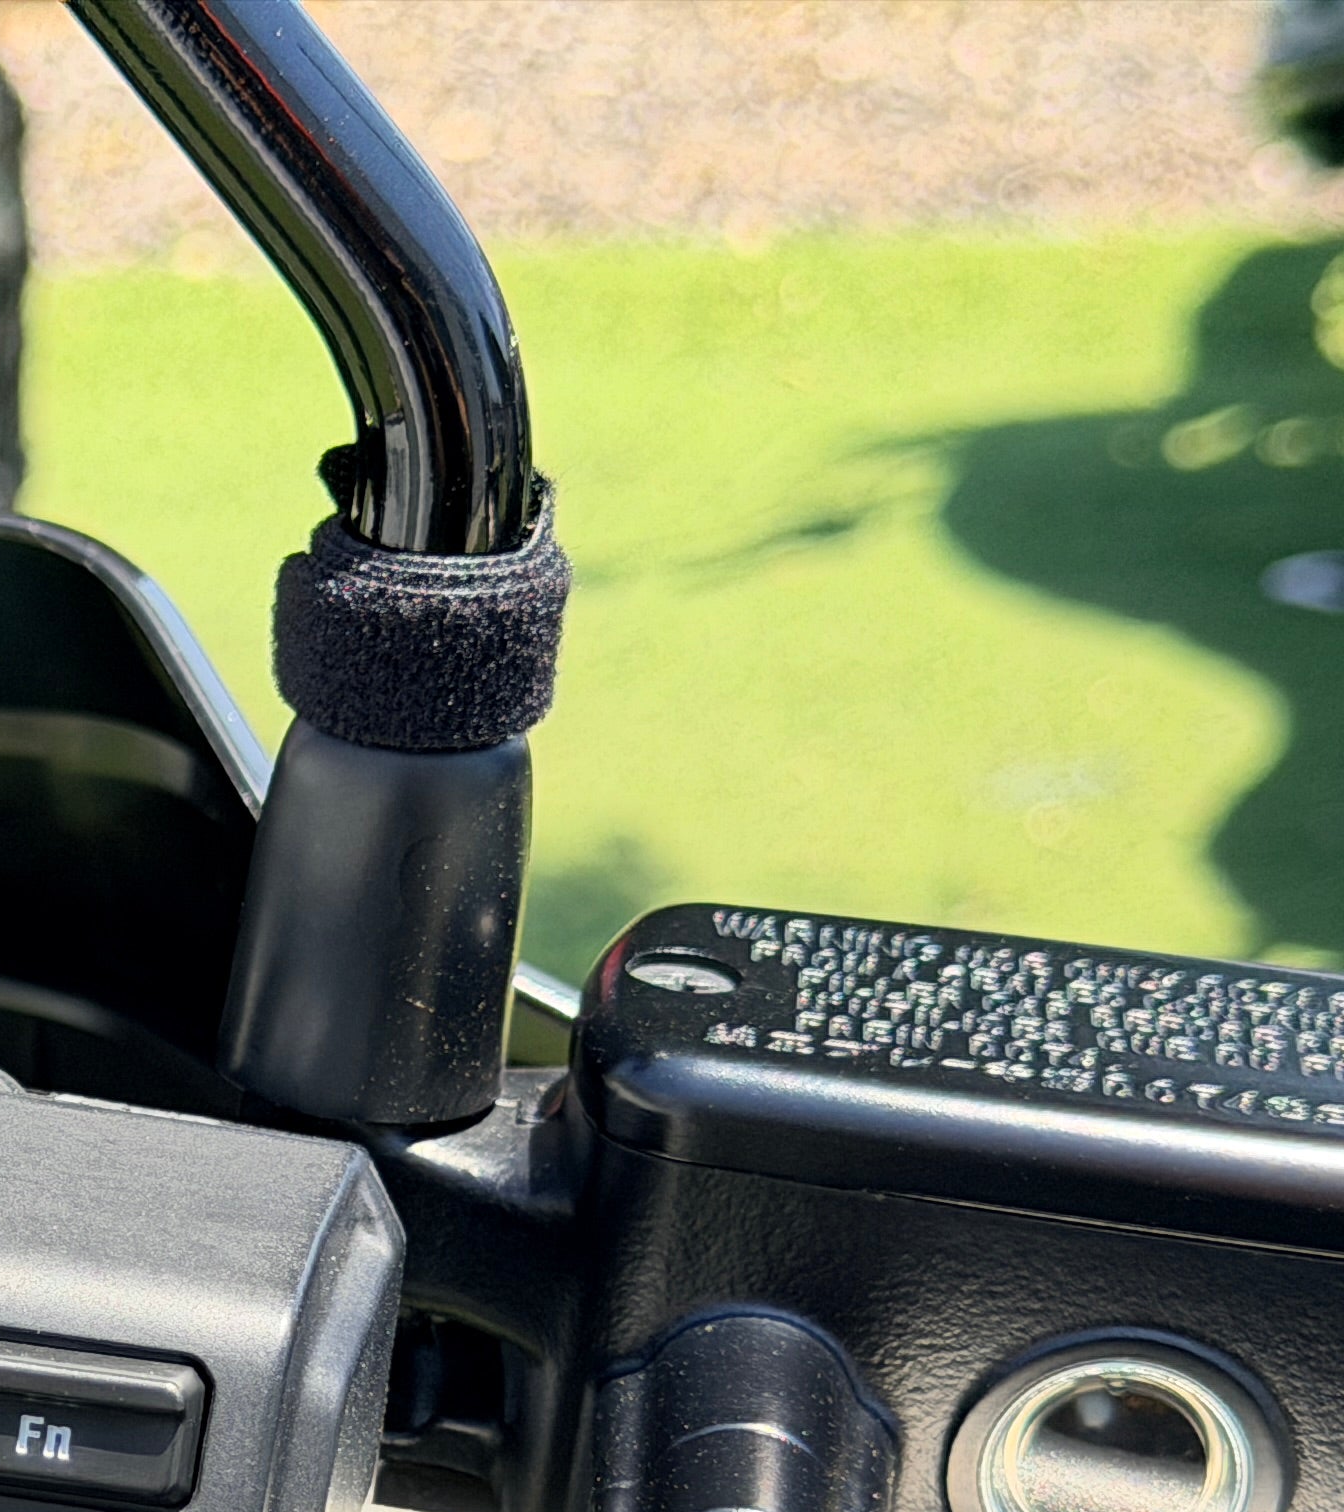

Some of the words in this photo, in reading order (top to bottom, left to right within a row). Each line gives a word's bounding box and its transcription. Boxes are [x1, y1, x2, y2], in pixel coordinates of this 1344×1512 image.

[713, 911, 943, 961] WARNING
[751, 939, 880, 977] FROM
[795, 1010, 944, 1051] FREIN
[15, 1414, 72, 1461] Fn
